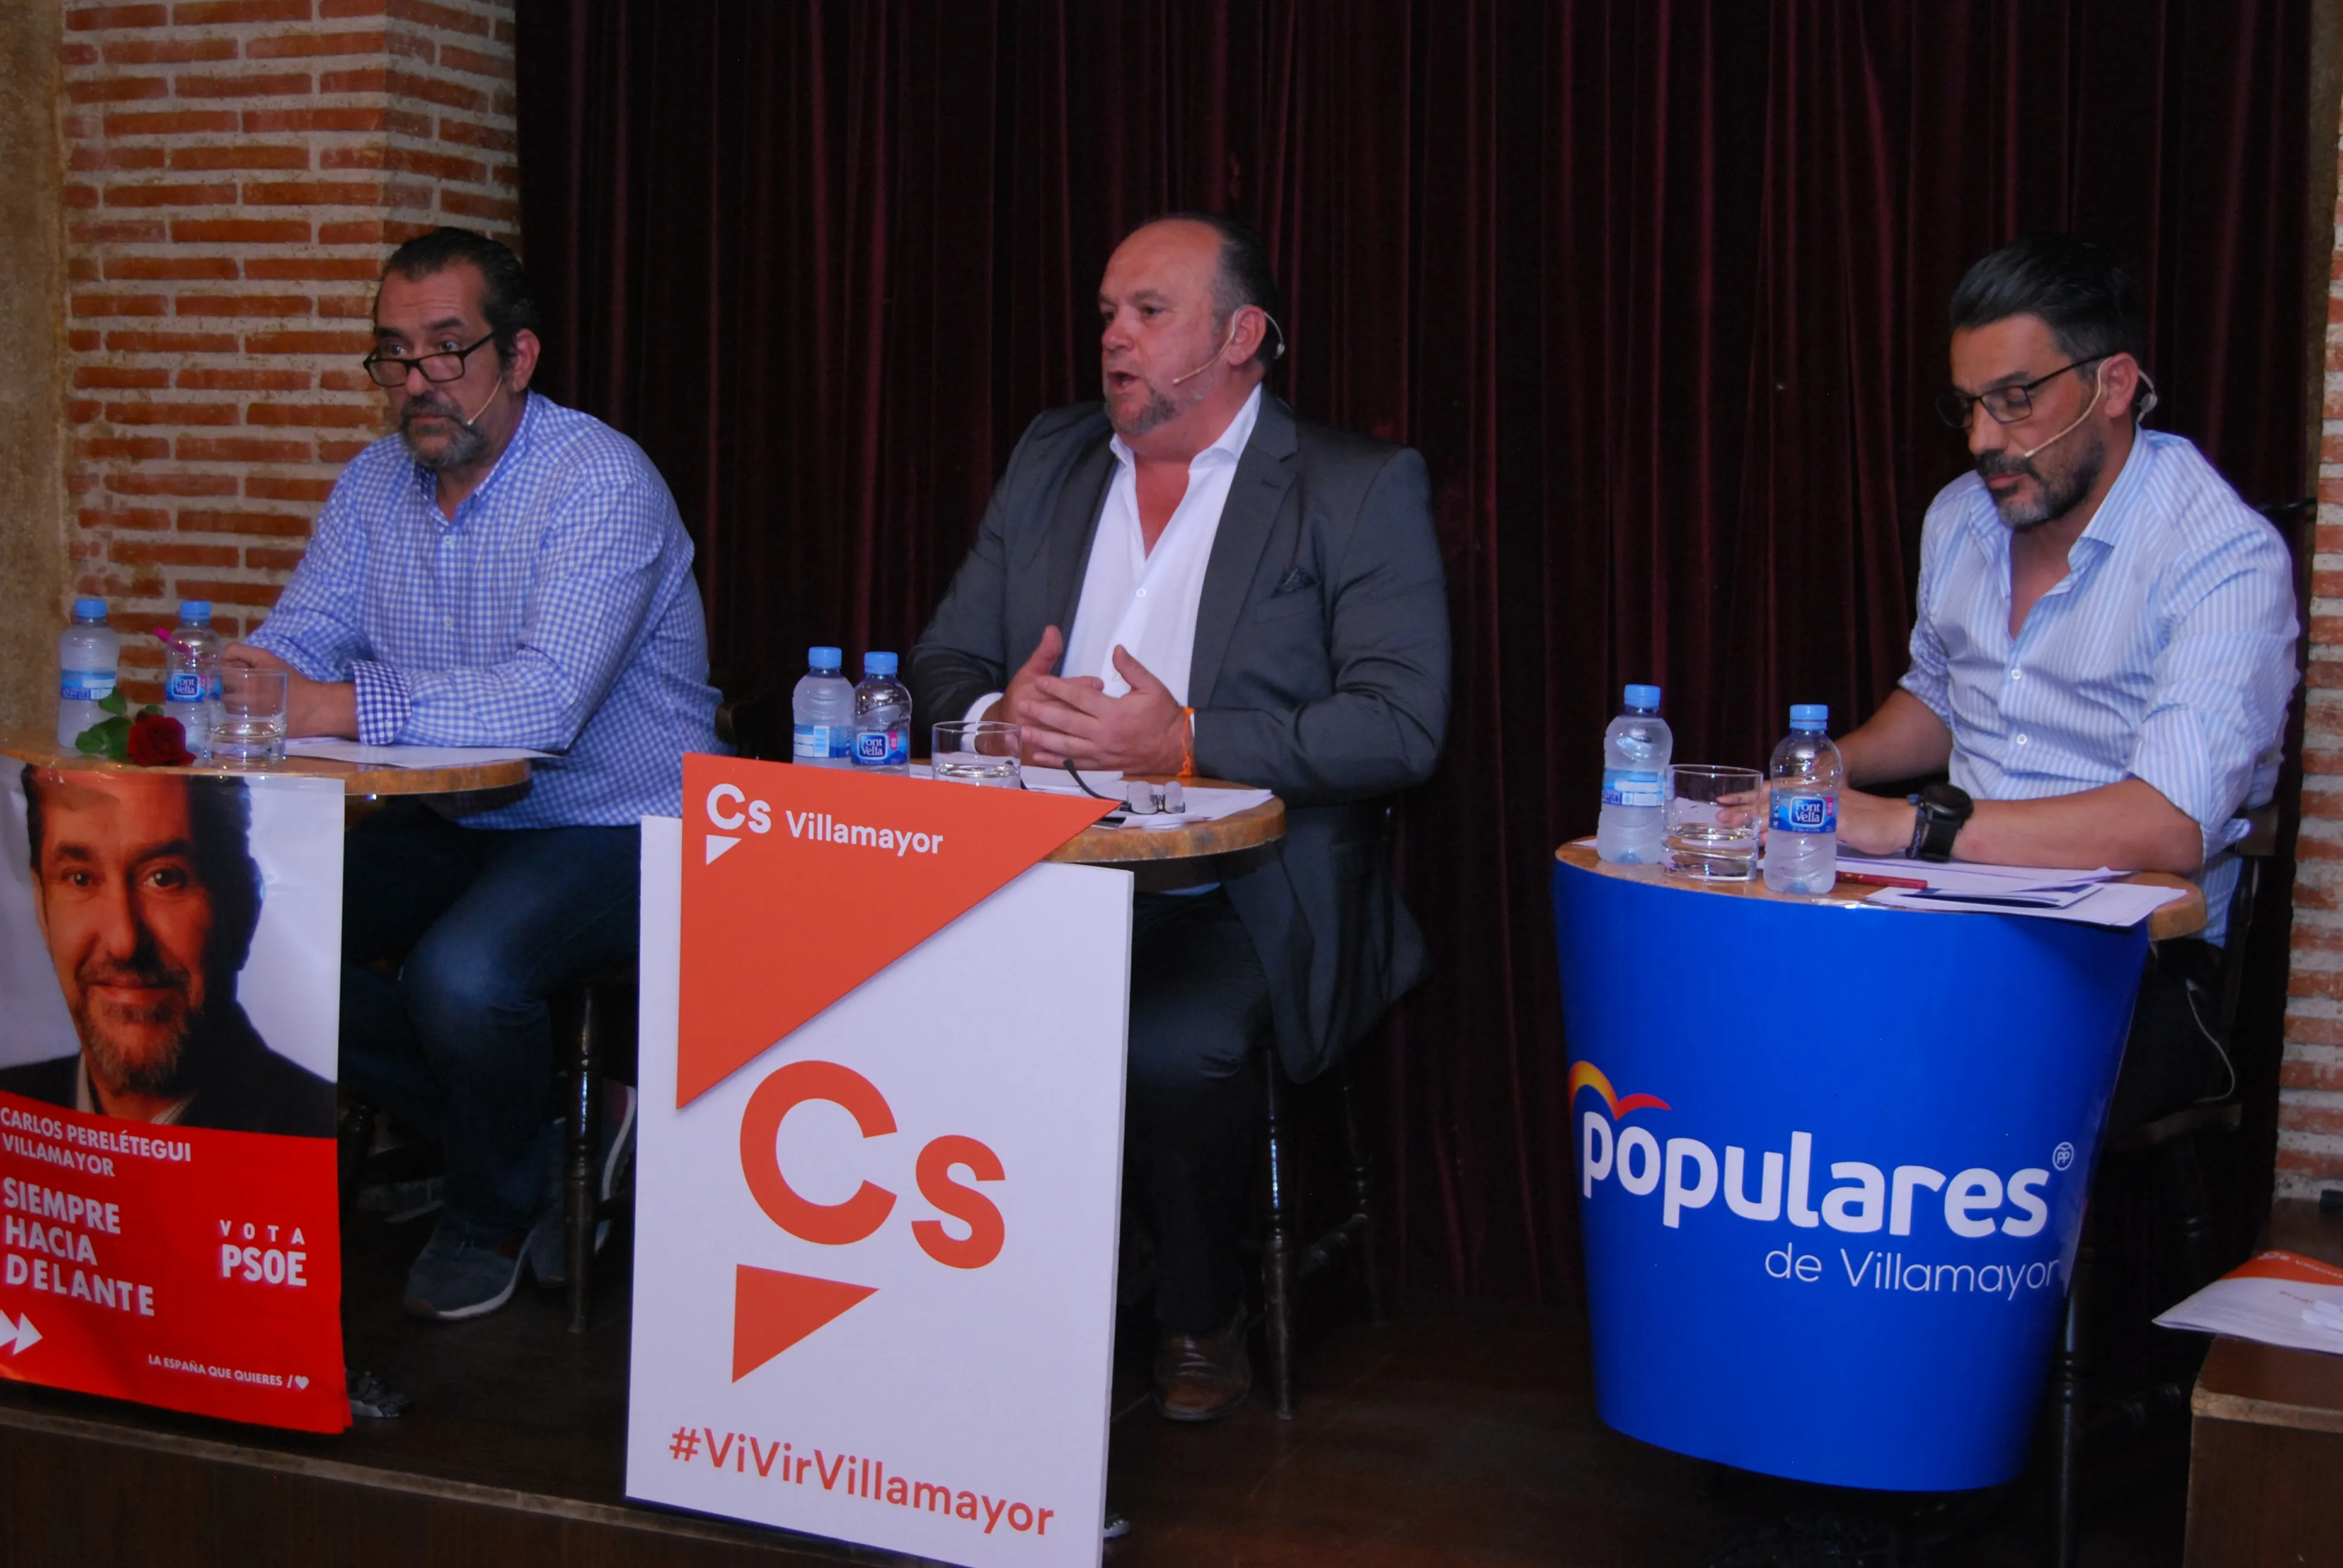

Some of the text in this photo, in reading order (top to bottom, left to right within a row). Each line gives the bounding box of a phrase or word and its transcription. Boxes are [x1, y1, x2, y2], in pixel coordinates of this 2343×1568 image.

[174, 685, 195, 695] Vella
[861, 745, 883, 756] Vella
[862, 736, 883, 746] Font
[706, 783, 943, 857] Cs Villamayor
[1795, 800, 1821, 812] Font
[1795, 811, 1821, 823] Vella
[0, 1107, 191, 1161] CARLOS PERELÉTEGUI
[2, 1132, 115, 1177] VILLAMAYOR
[739, 1060, 1006, 1270] Cs
[1583, 1111, 2050, 1238] populares
[4, 1177, 120, 1235] SIEMPRE
[6, 1215, 98, 1266] HACIA
[220, 1220, 306, 1245] VOTA
[6, 1254, 155, 1316] DELANTE
[222, 1244, 307, 1287] PSOE
[1765, 1243, 2059, 1301] de Villamayor
[148, 1354, 283, 1387] LA ESPAÑA QUE QUIERES
[669, 1426, 1054, 1535] #ViVirVillamayor
